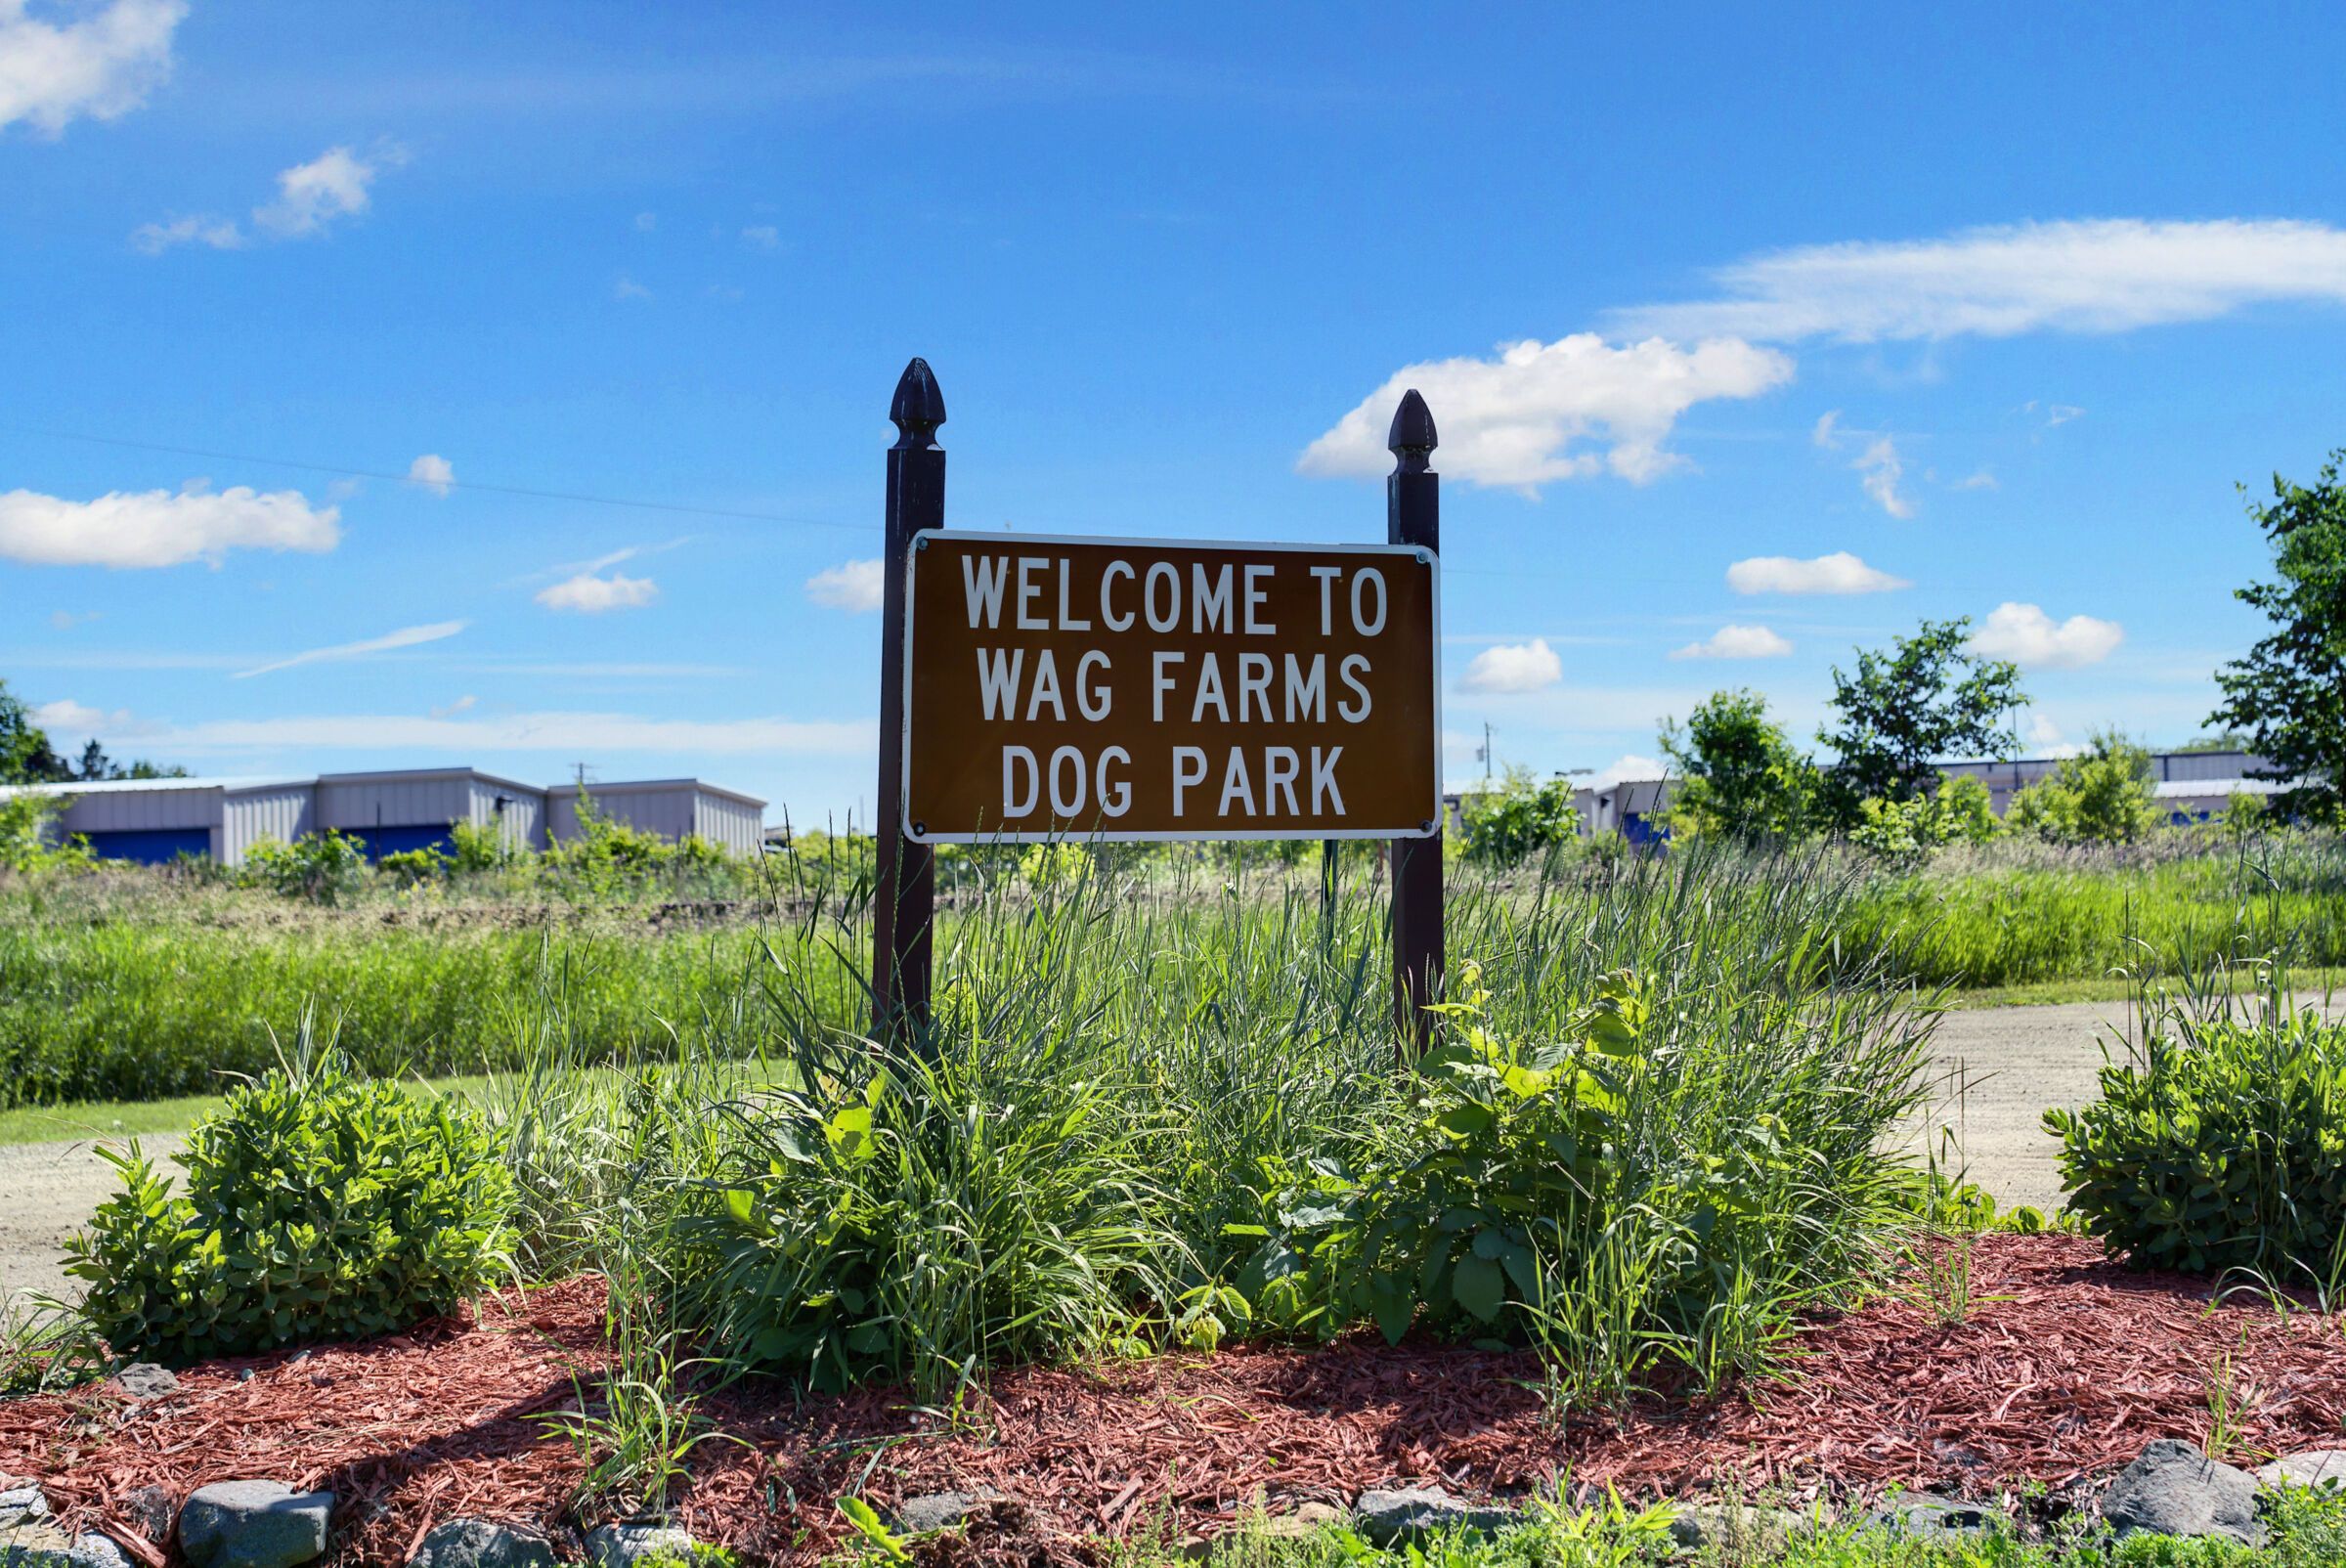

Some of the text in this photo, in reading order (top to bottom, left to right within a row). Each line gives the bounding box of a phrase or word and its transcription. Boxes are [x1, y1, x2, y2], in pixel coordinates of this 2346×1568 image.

[962, 554, 1388, 636] WELCOME TO
[977, 648, 1372, 723] WAG FARMS
[1003, 745, 1347, 818] DOG PARK
